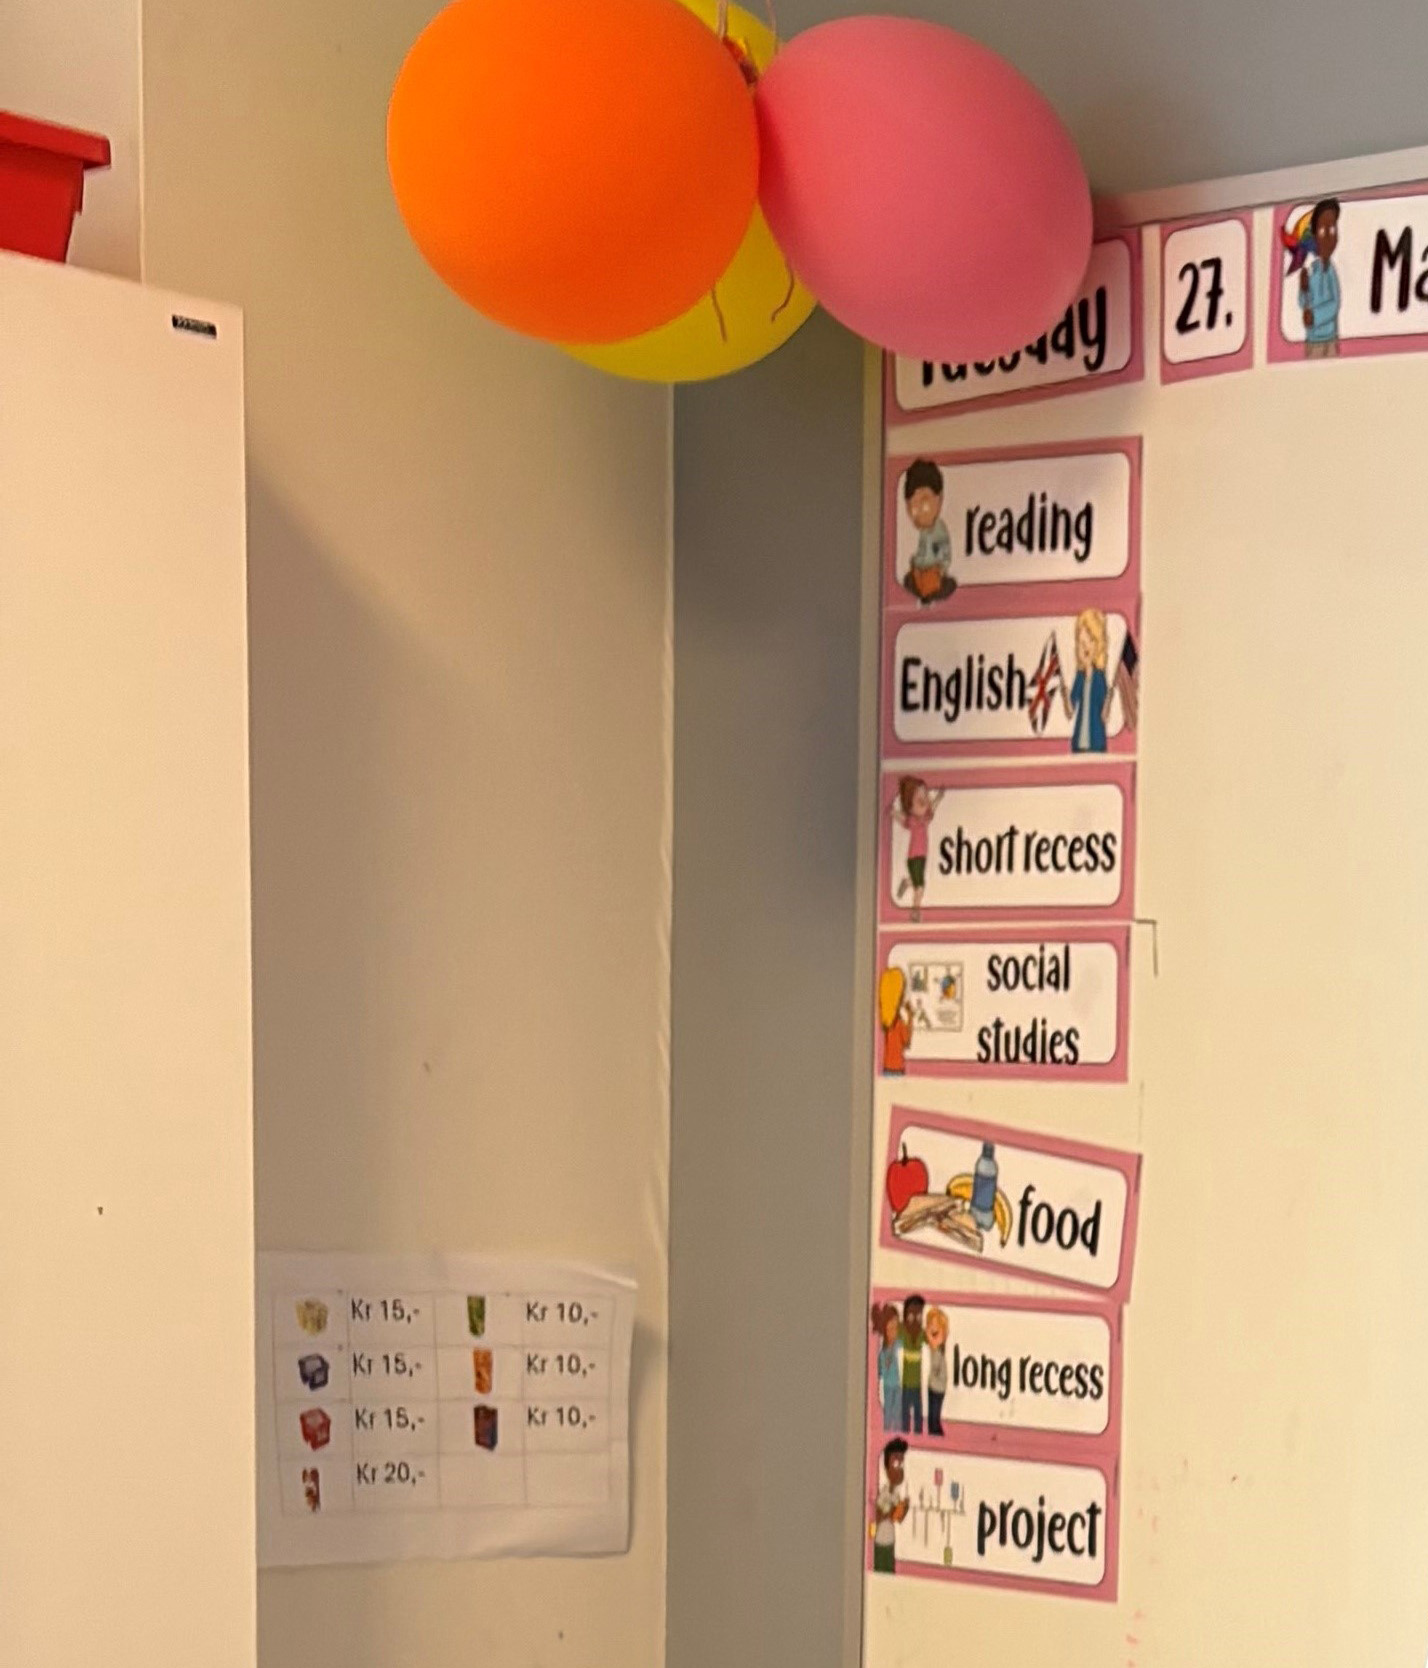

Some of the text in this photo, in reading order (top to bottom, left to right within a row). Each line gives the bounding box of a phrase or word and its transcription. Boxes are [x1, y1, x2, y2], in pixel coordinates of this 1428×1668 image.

[1175, 258, 1232, 334] 27.
[964, 492, 1094, 562] reading
[900, 652, 1027, 723] English
[938, 824, 1118, 877] short recess
[986, 943, 1072, 993] social
[977, 1016, 1080, 1066] studies
[1016, 1184, 1103, 1258] food
[350, 1298, 373, 1321] Kr
[525, 1302, 547, 1323] Kr
[352, 1352, 373, 1375] Kr
[525, 1352, 547, 1374] Kr
[952, 1343, 1105, 1401] long recess
[354, 1407, 377, 1430] Kr
[526, 1405, 548, 1427] Kr
[356, 1462, 379, 1485] Kr
[976, 1496, 1101, 1564] project
